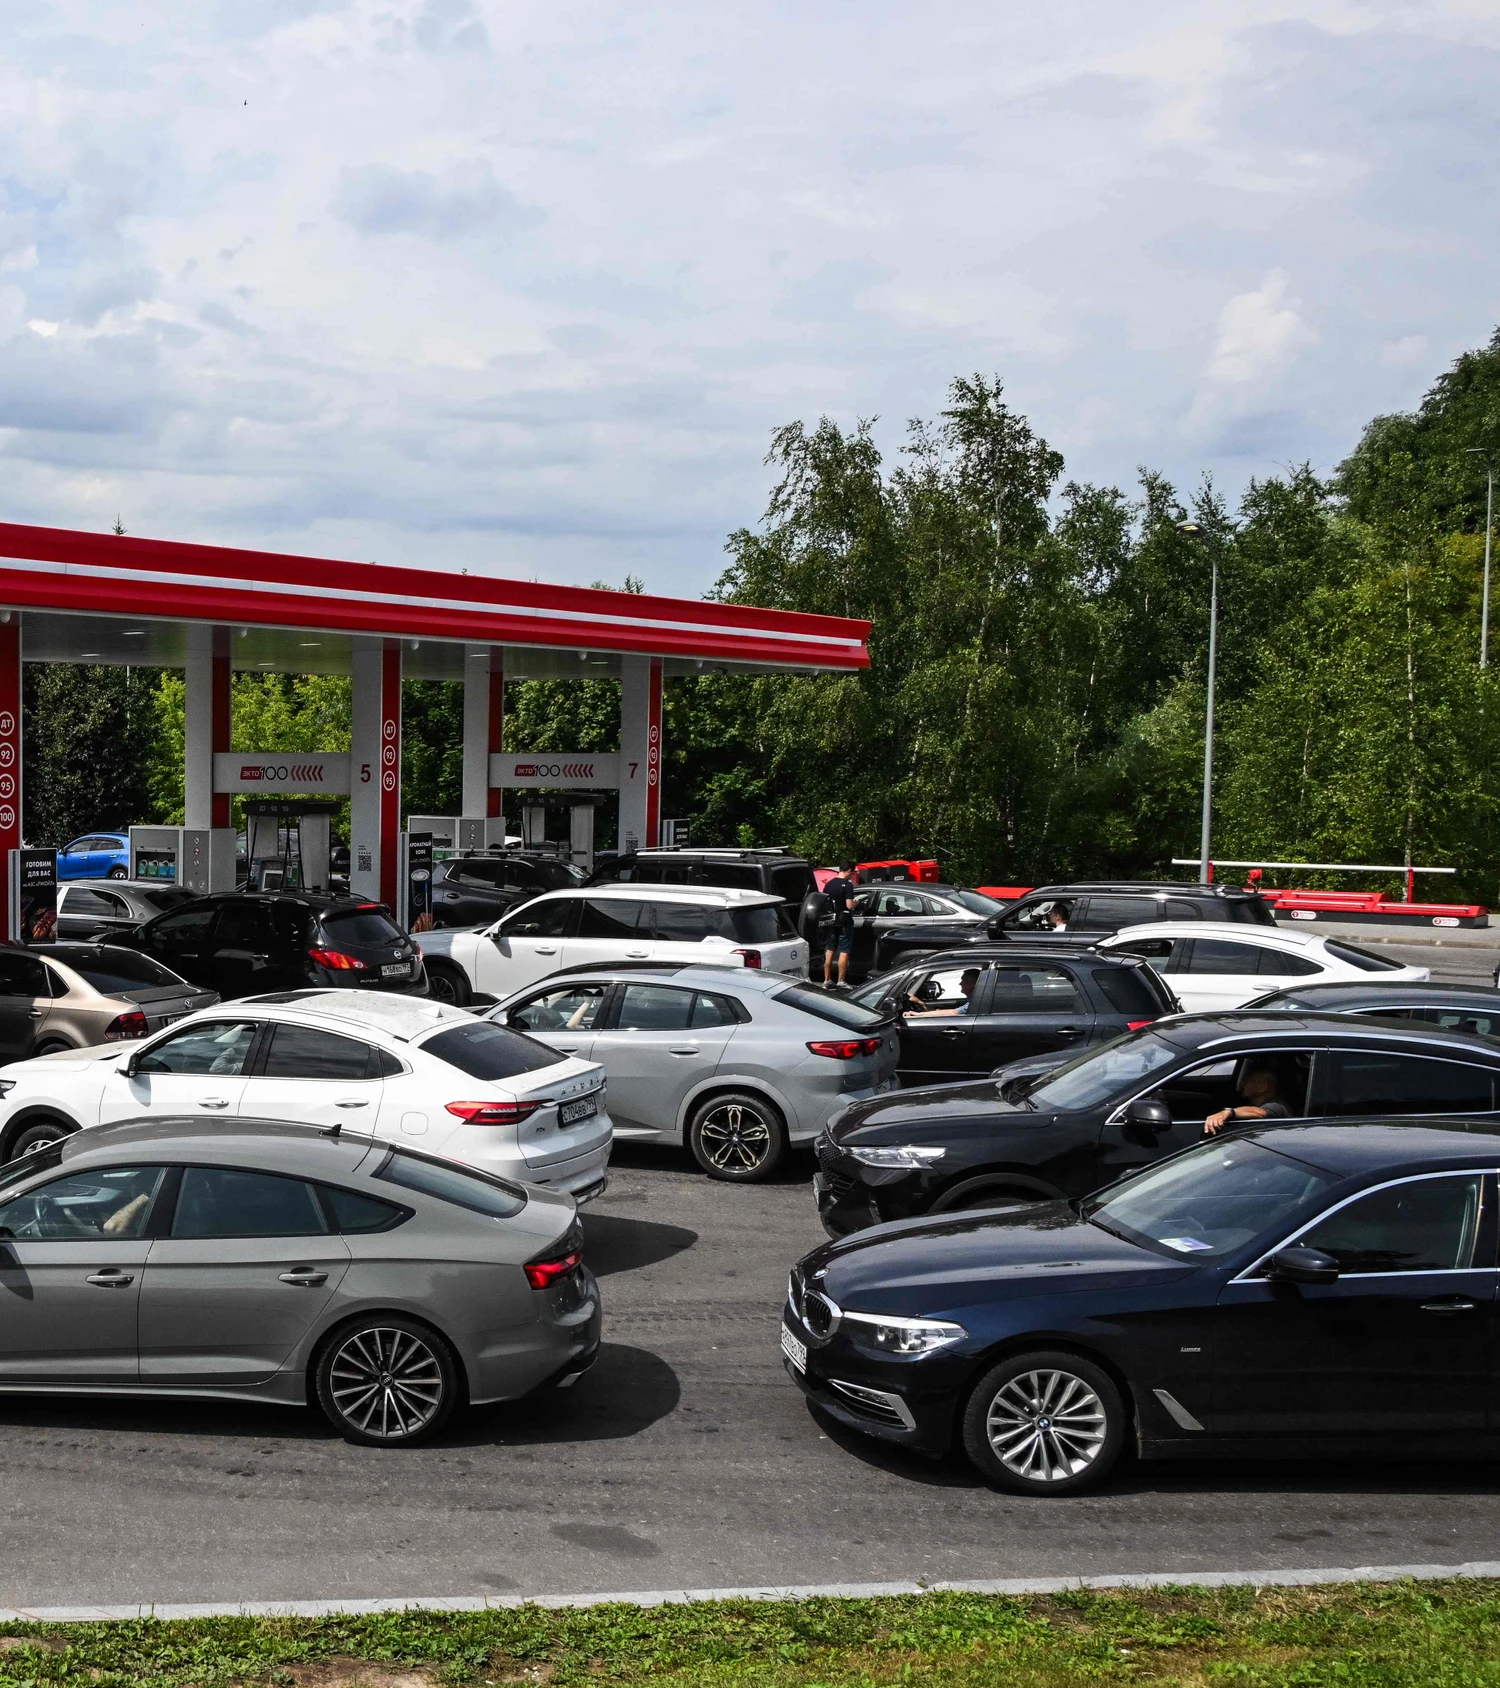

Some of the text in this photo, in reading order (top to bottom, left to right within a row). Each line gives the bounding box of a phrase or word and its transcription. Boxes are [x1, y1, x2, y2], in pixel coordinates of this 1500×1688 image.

[0, 718, 11, 729] ДТ
[0, 750, 11, 760] 92
[385, 751, 393, 760] 92
[360, 763, 371, 783] 5
[628, 763, 638, 779] 7
[385, 776, 393, 785] 95
[0, 781, 11, 791] 95
[0, 812, 13, 822] 100
